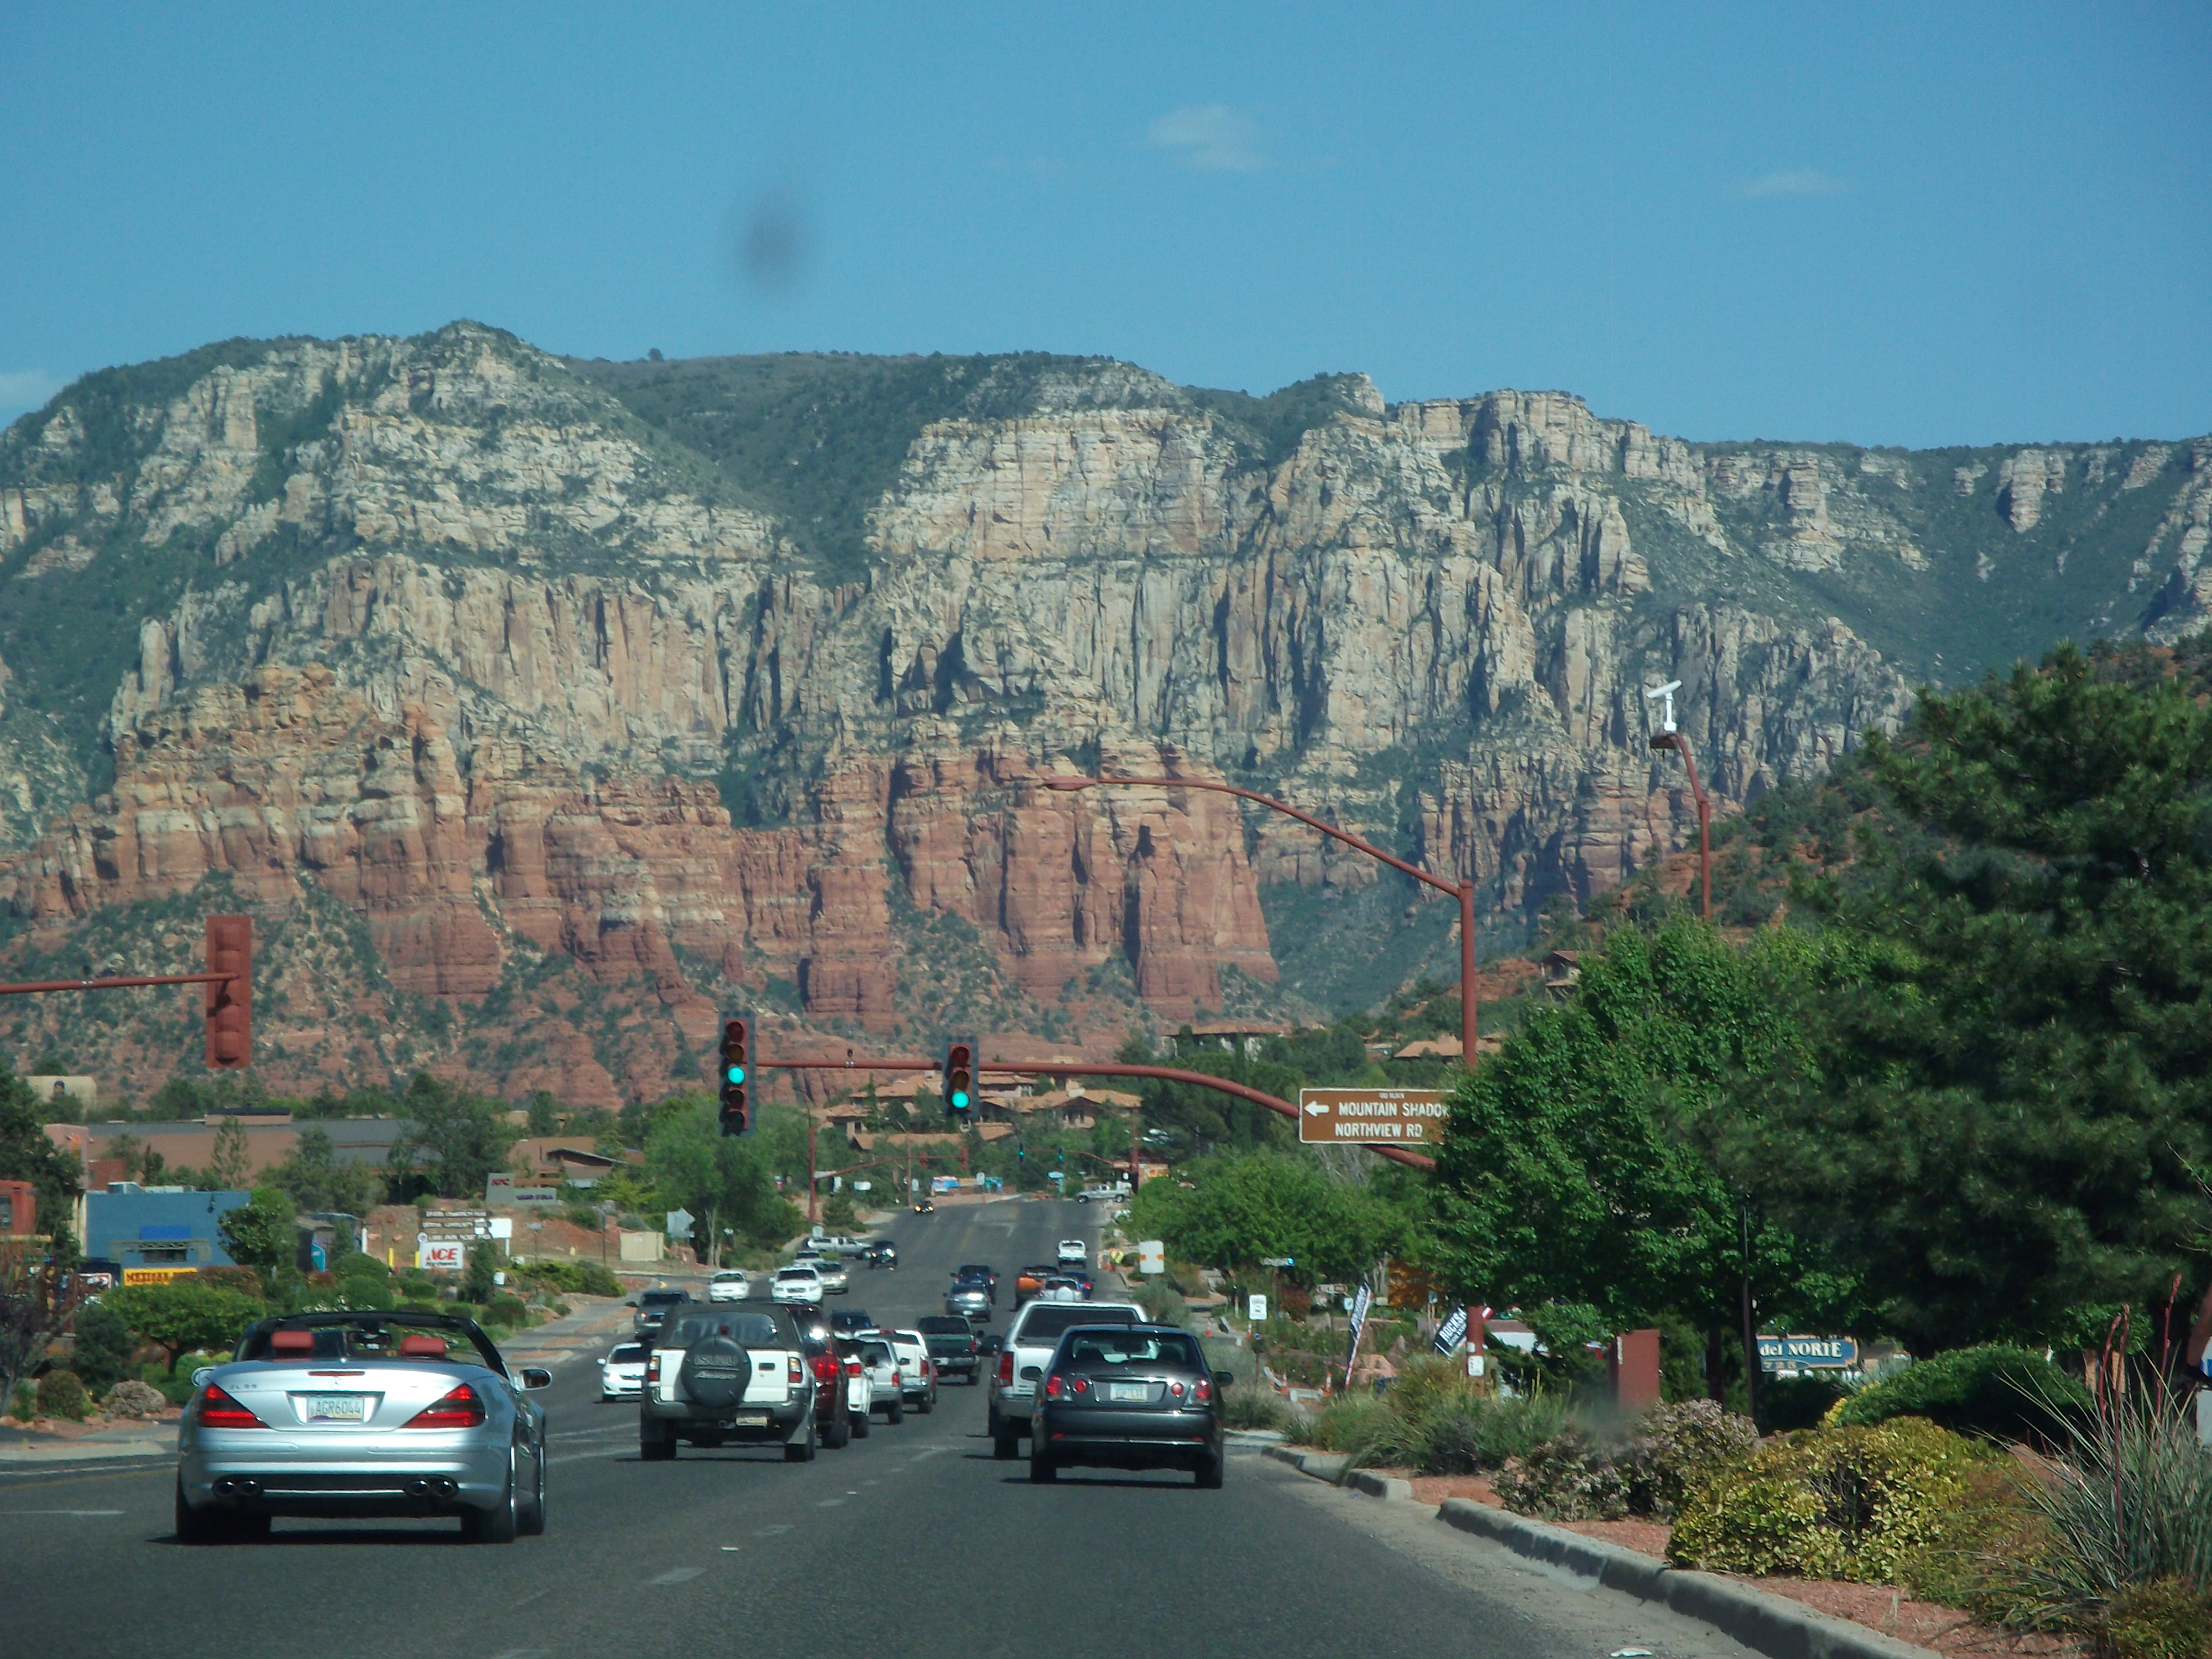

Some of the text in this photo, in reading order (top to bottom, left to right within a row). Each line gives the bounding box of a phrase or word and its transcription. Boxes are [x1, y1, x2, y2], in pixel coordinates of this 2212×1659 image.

[1338, 1102, 1398, 1117] MOUNTAIN
[1335, 1123, 1423, 1138] NORTHVIEW RD
[426, 1248, 458, 1261] ACE
[1760, 1342, 1843, 1358] del NORTE
[316, 1401, 361, 1415] AGR6044
